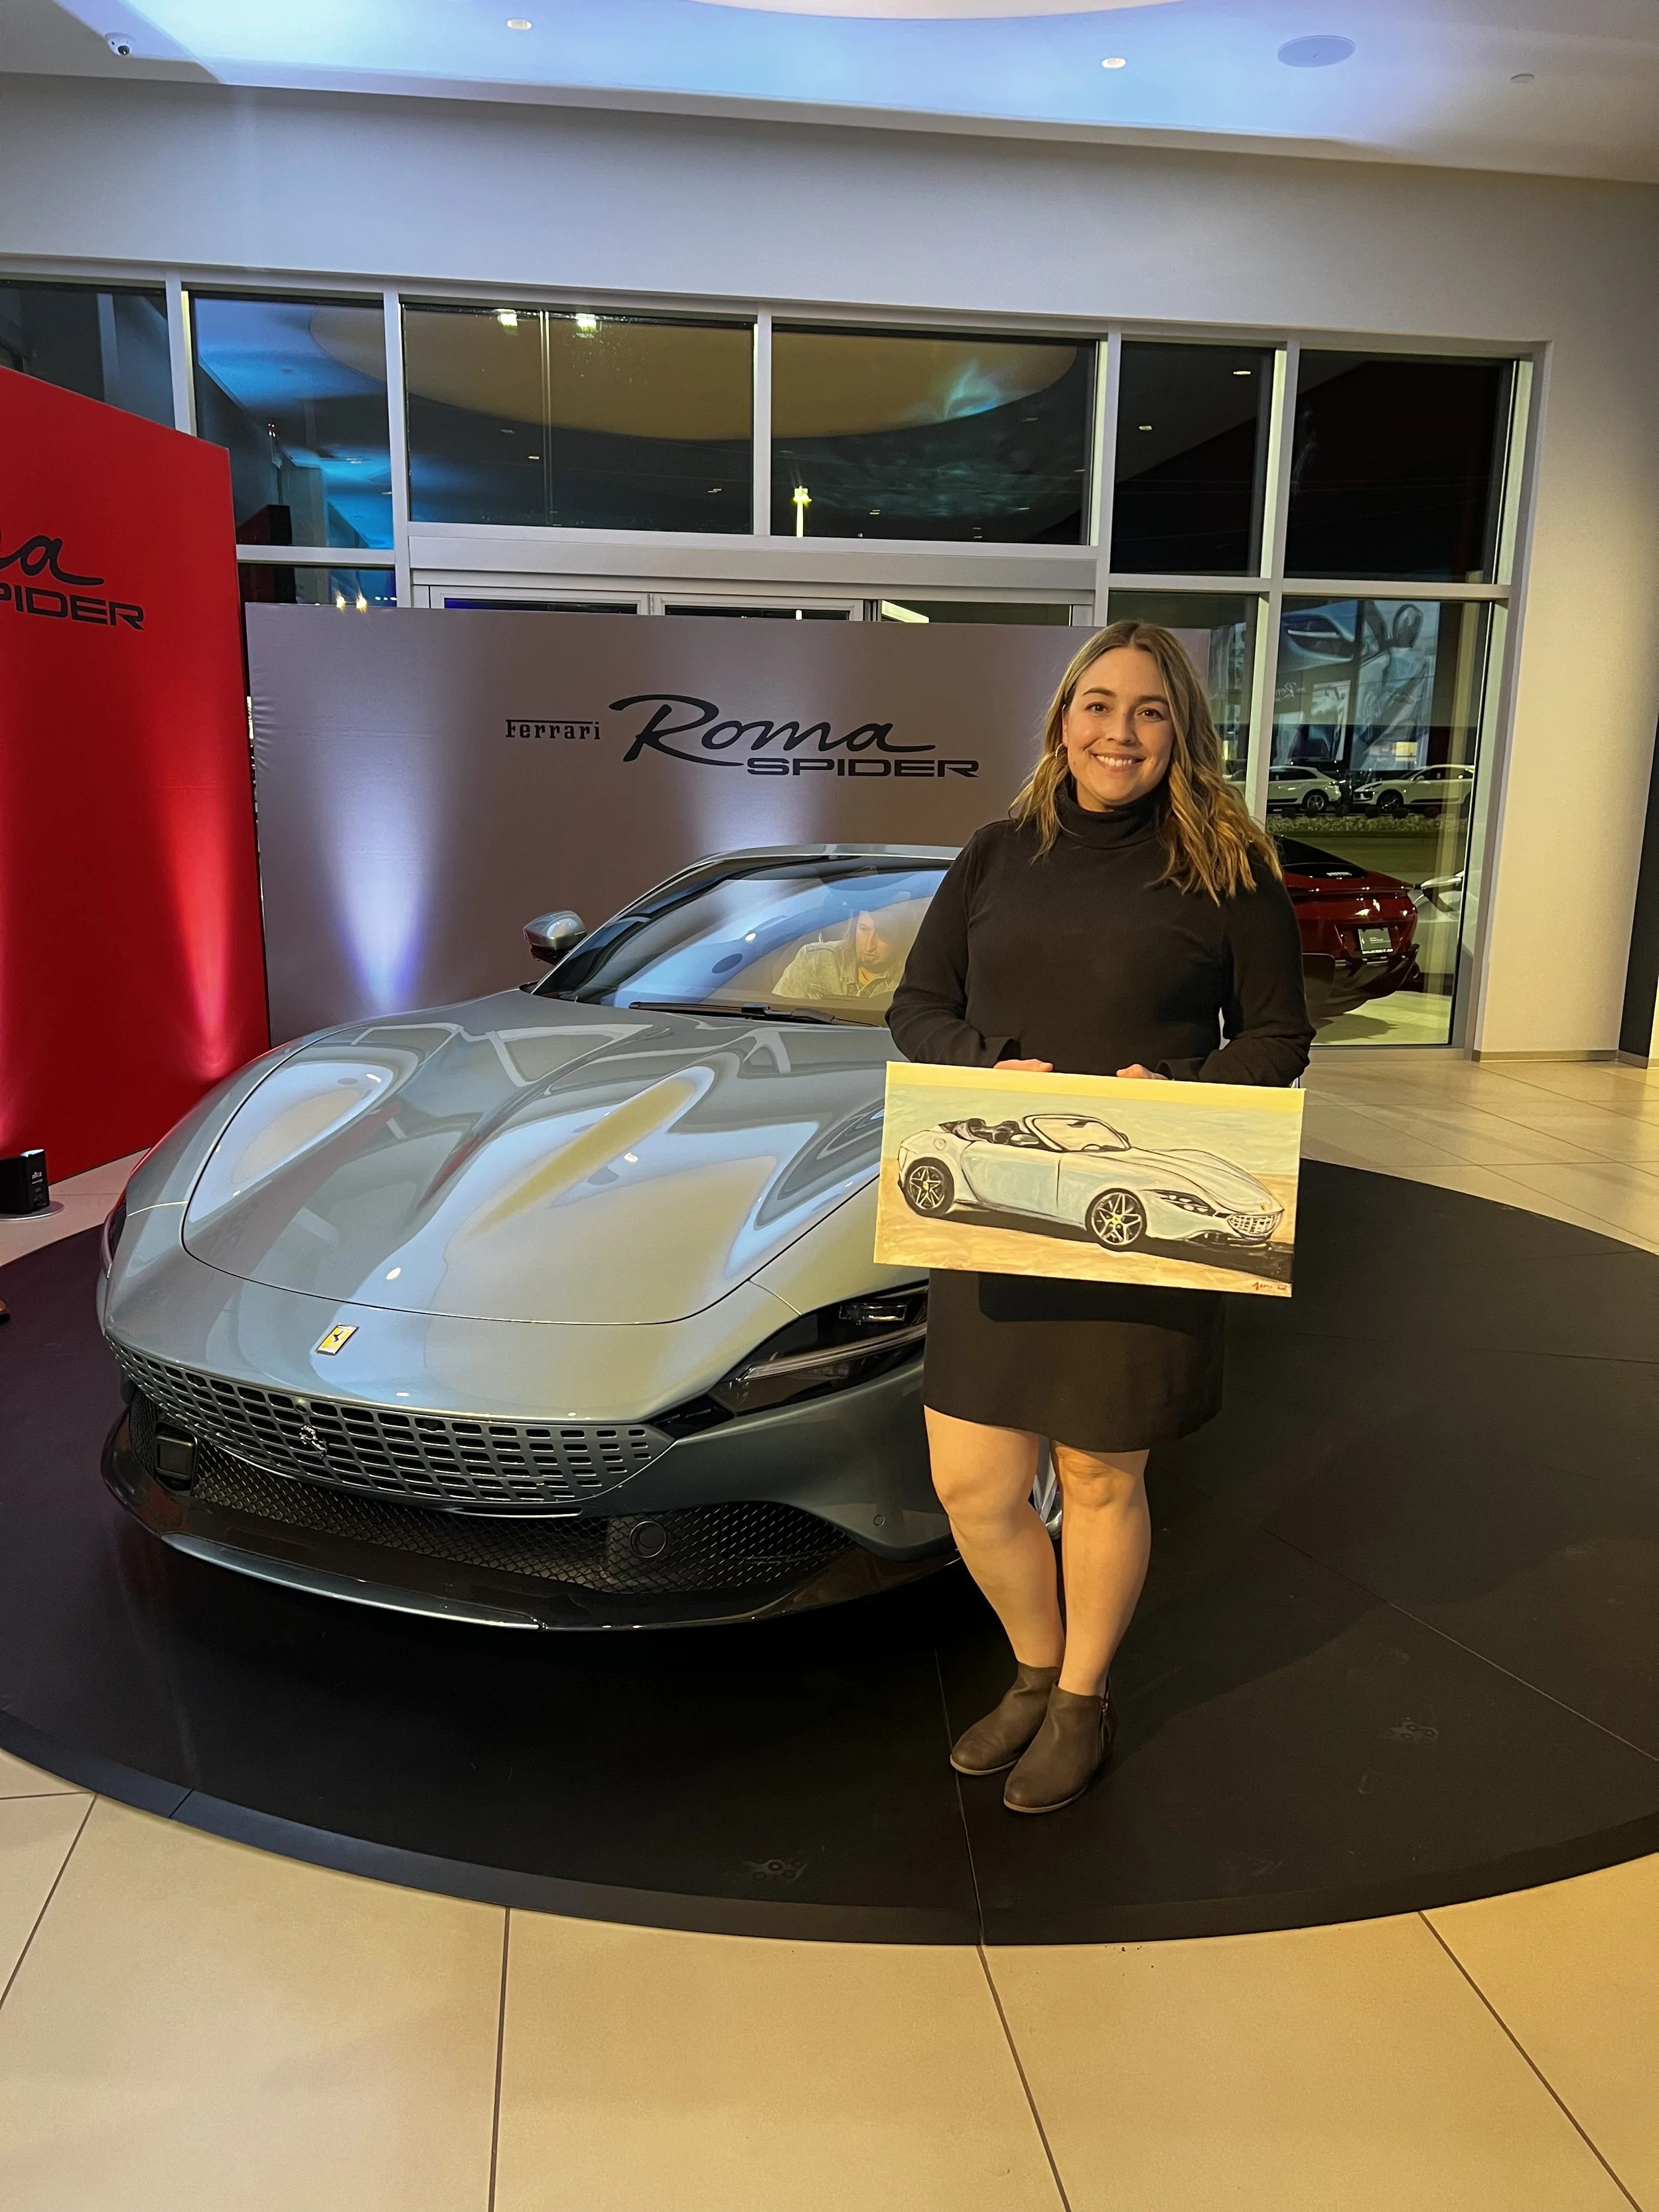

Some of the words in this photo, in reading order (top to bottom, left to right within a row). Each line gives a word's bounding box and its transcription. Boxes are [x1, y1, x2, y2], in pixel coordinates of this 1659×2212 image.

[506, 719, 601, 739] Ferrari
[609, 694, 936, 766] Roma
[747, 758, 979, 777] SPIDER
